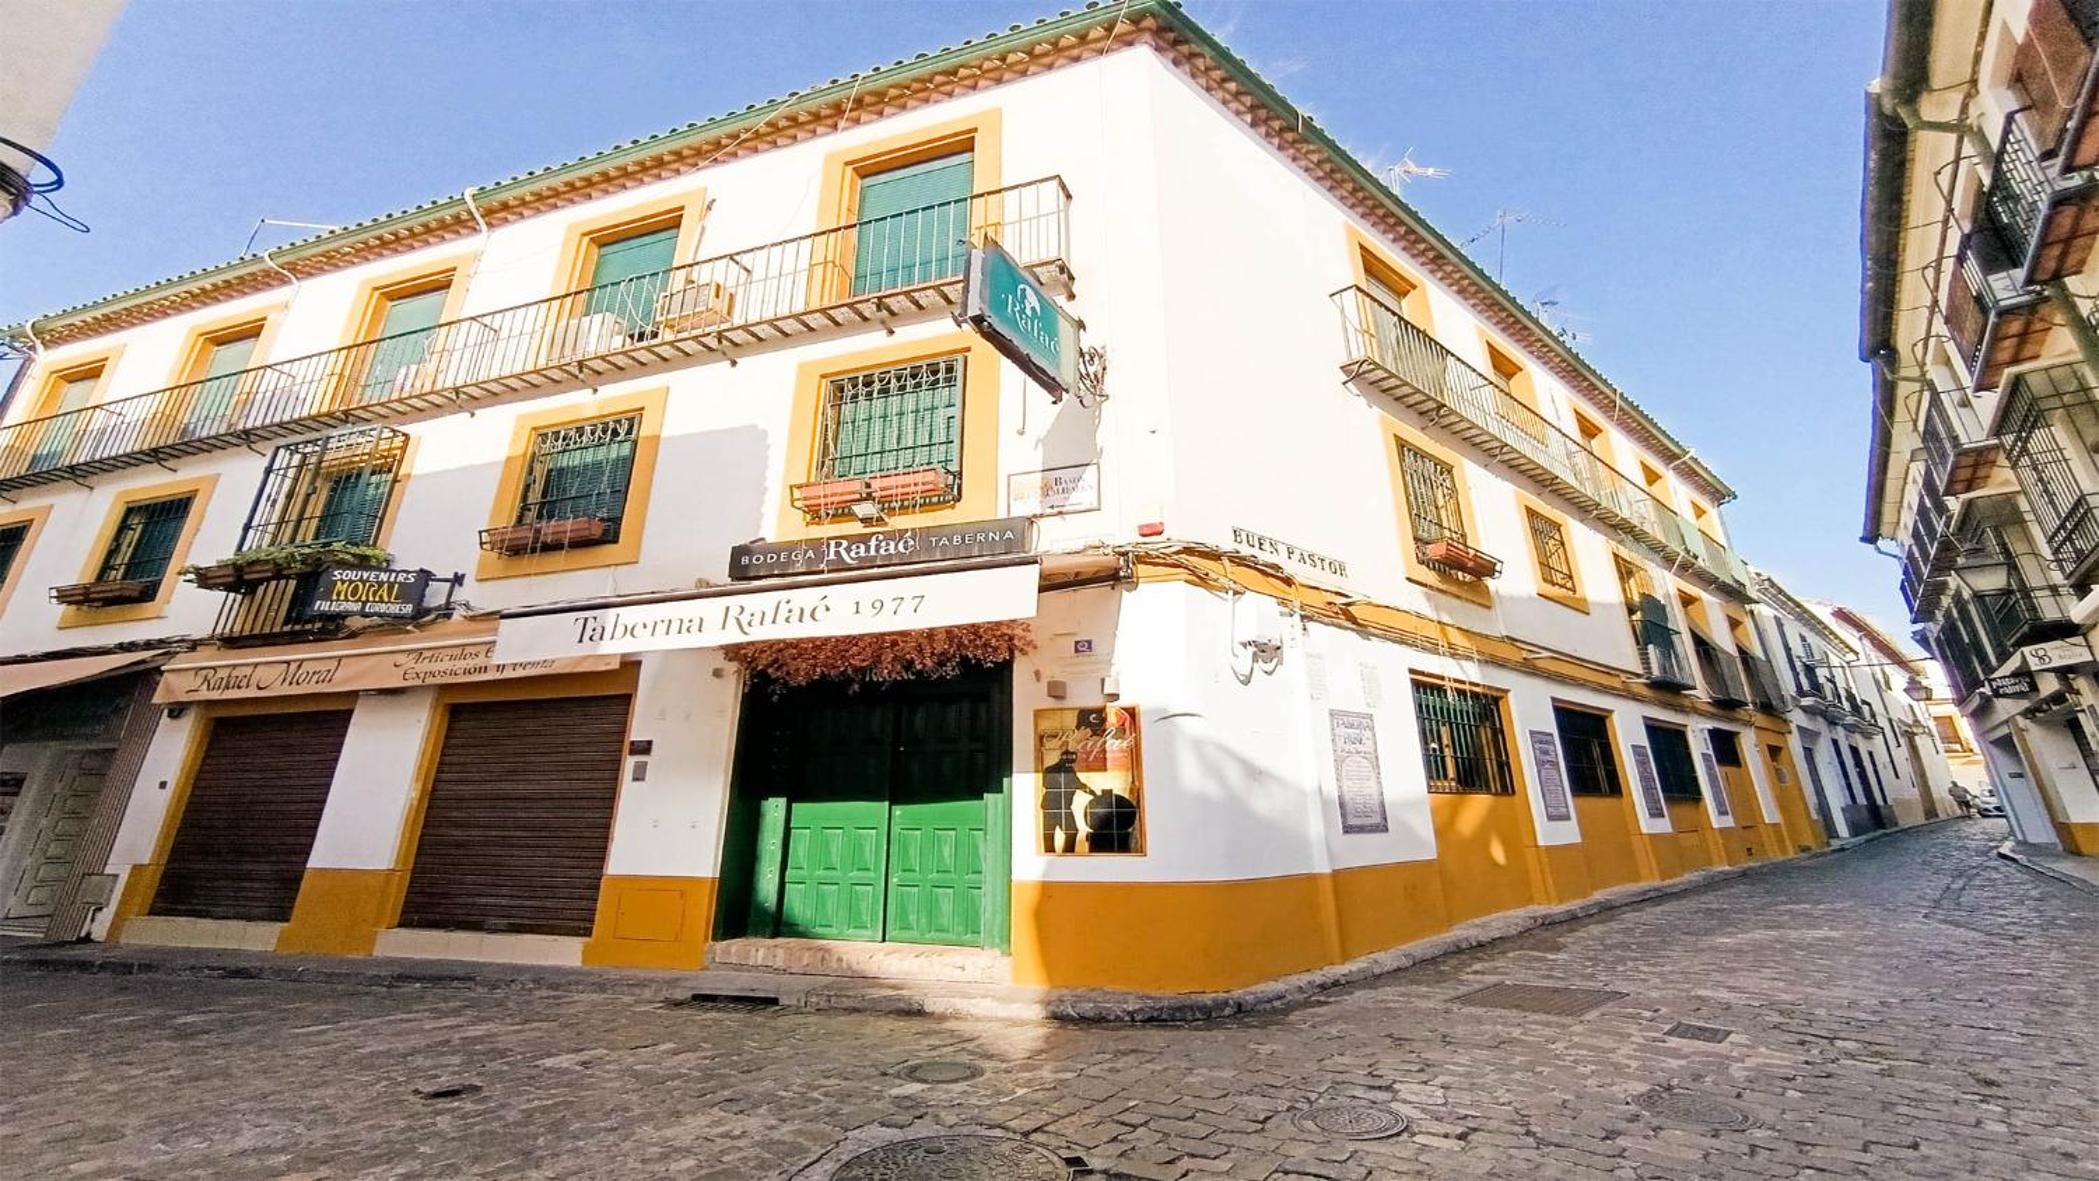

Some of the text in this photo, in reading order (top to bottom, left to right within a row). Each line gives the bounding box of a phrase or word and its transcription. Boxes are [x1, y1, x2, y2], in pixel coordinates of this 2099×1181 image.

[740, 529, 1016, 567] BODEGA Rafaé TABERNA
[1232, 528, 1349, 578] BUEN PASTOR
[331, 569, 417, 583] SOUVENIRS
[331, 579, 402, 603] MORAL
[573, 594, 926, 645] Taberna Rafaé 1977
[392, 646, 481, 668] Artículos
[402, 661, 489, 684] Exposición
[184, 657, 343, 696] Rafael Moral
